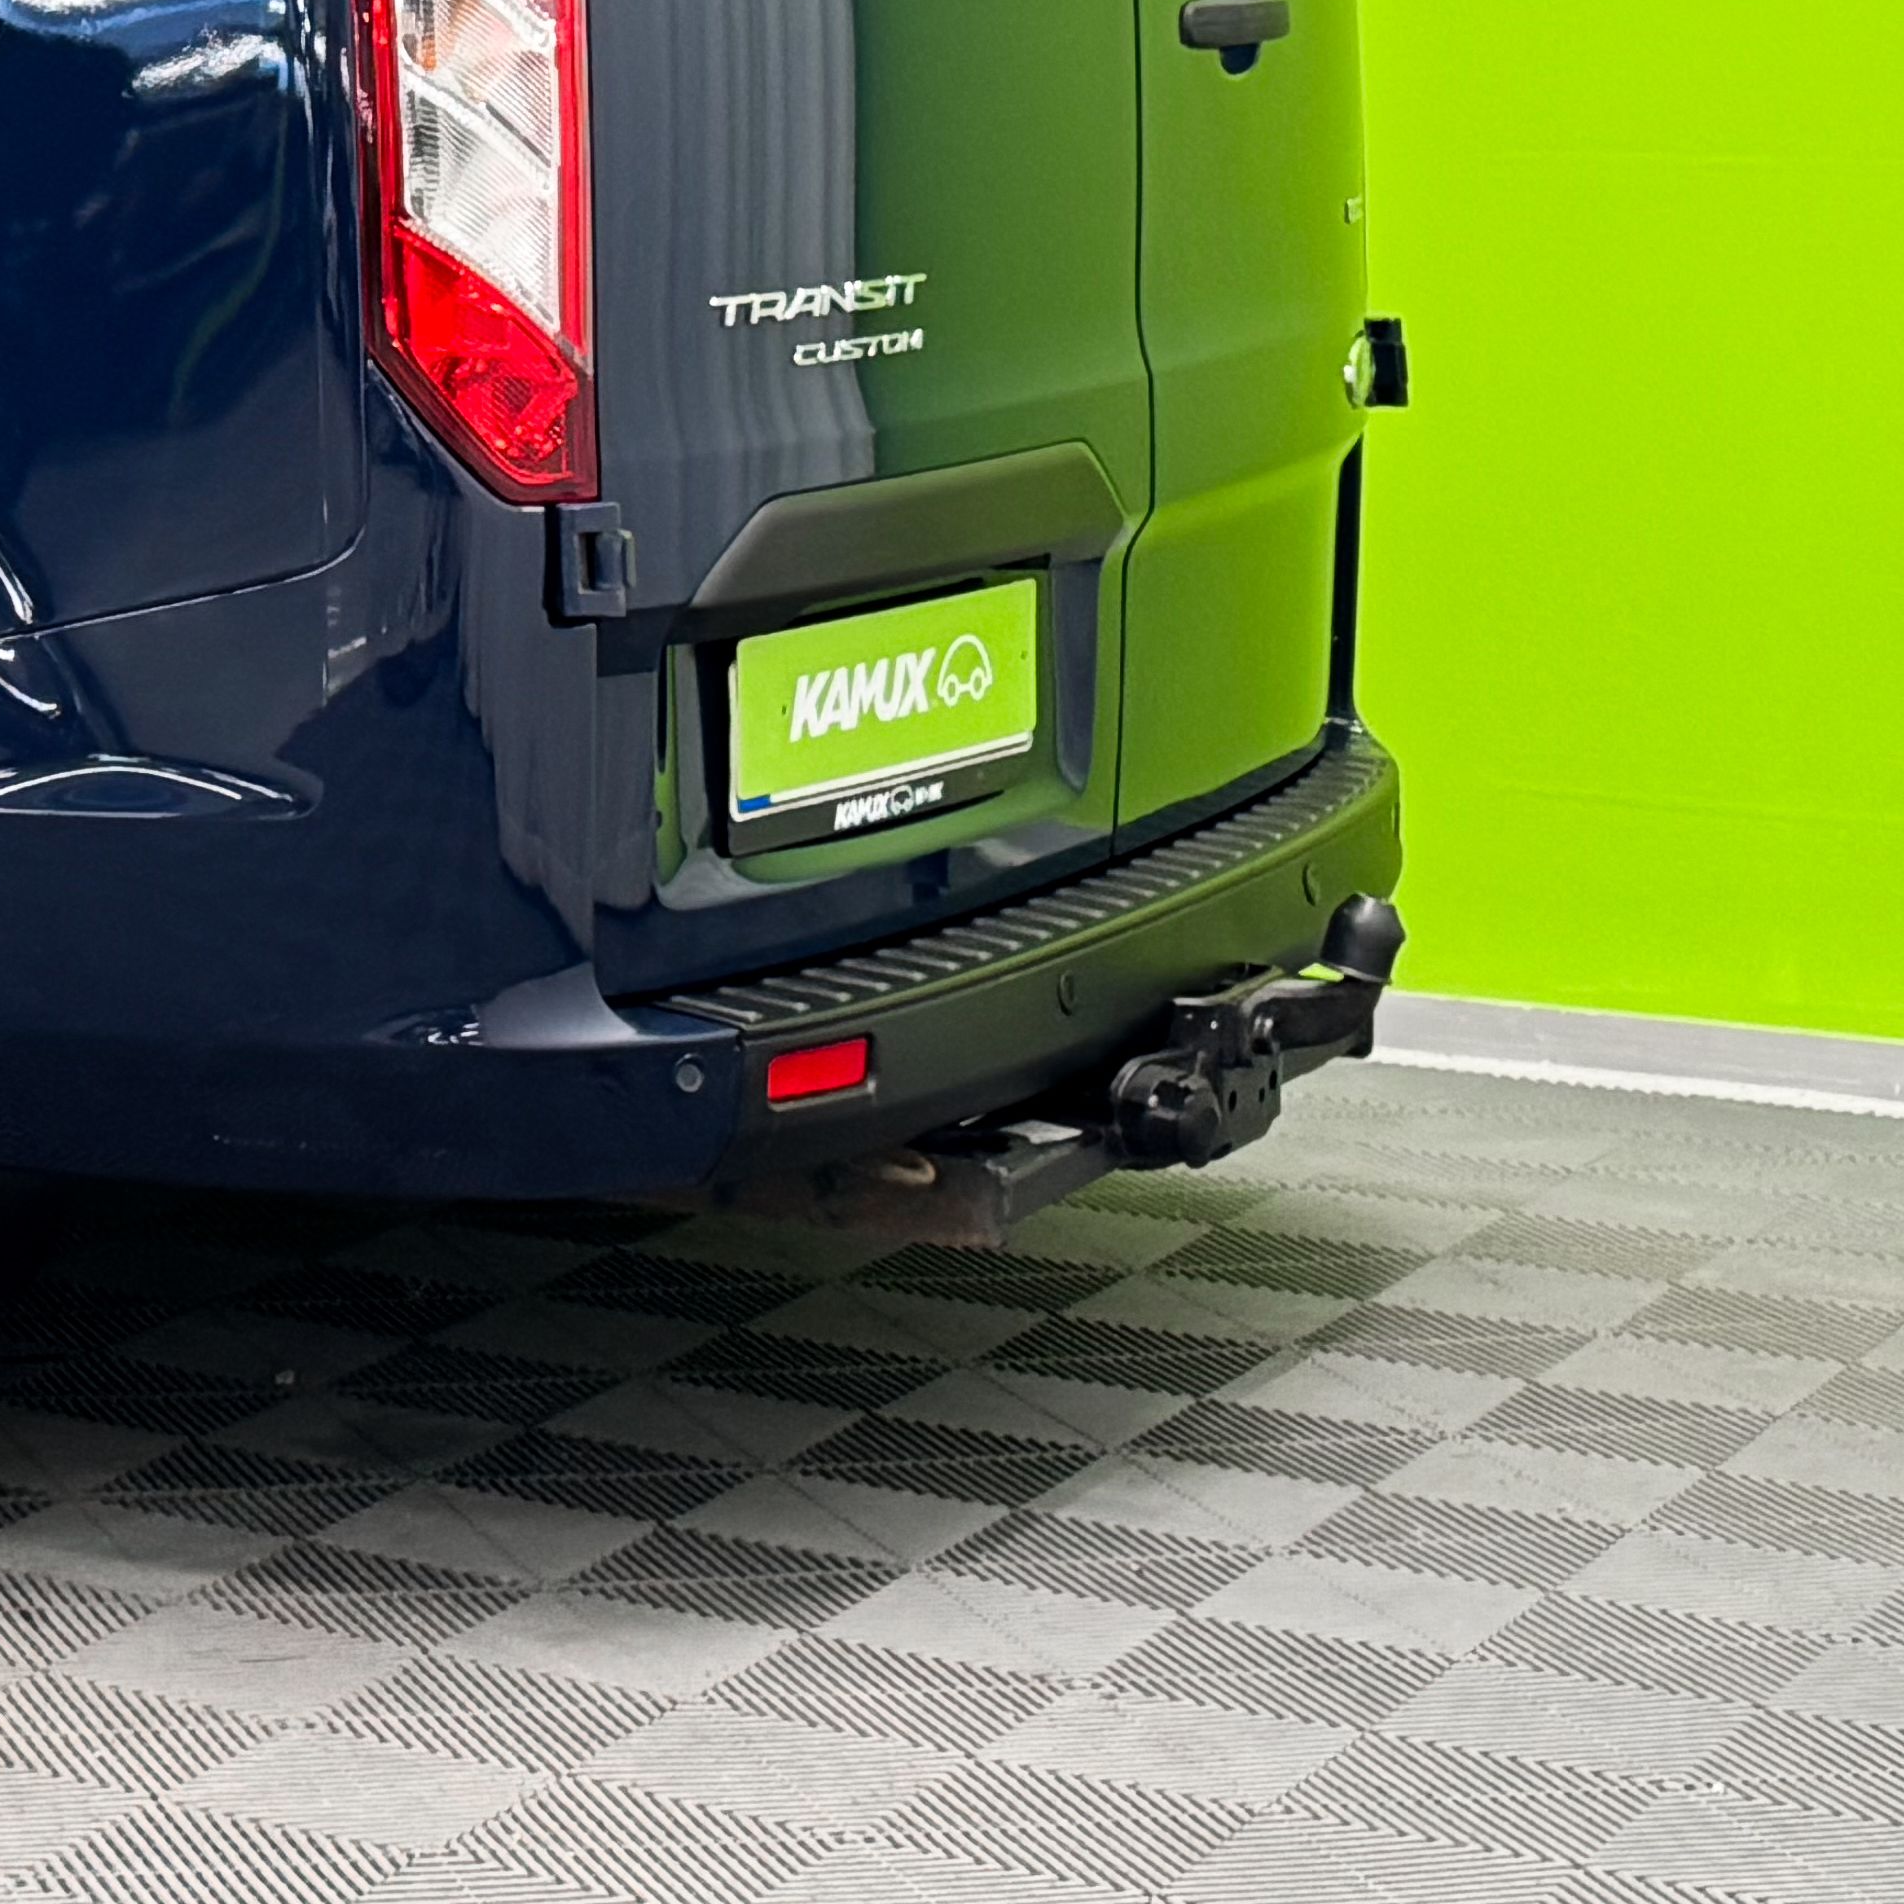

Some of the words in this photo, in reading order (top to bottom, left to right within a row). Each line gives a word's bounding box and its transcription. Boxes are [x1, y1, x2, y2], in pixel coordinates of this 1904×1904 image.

[709, 272, 927, 327] TRANSIT
[793, 328, 924, 366] CUSTOM
[789, 647, 937, 743] KAMUX
[834, 791, 891, 831] KAMUX
